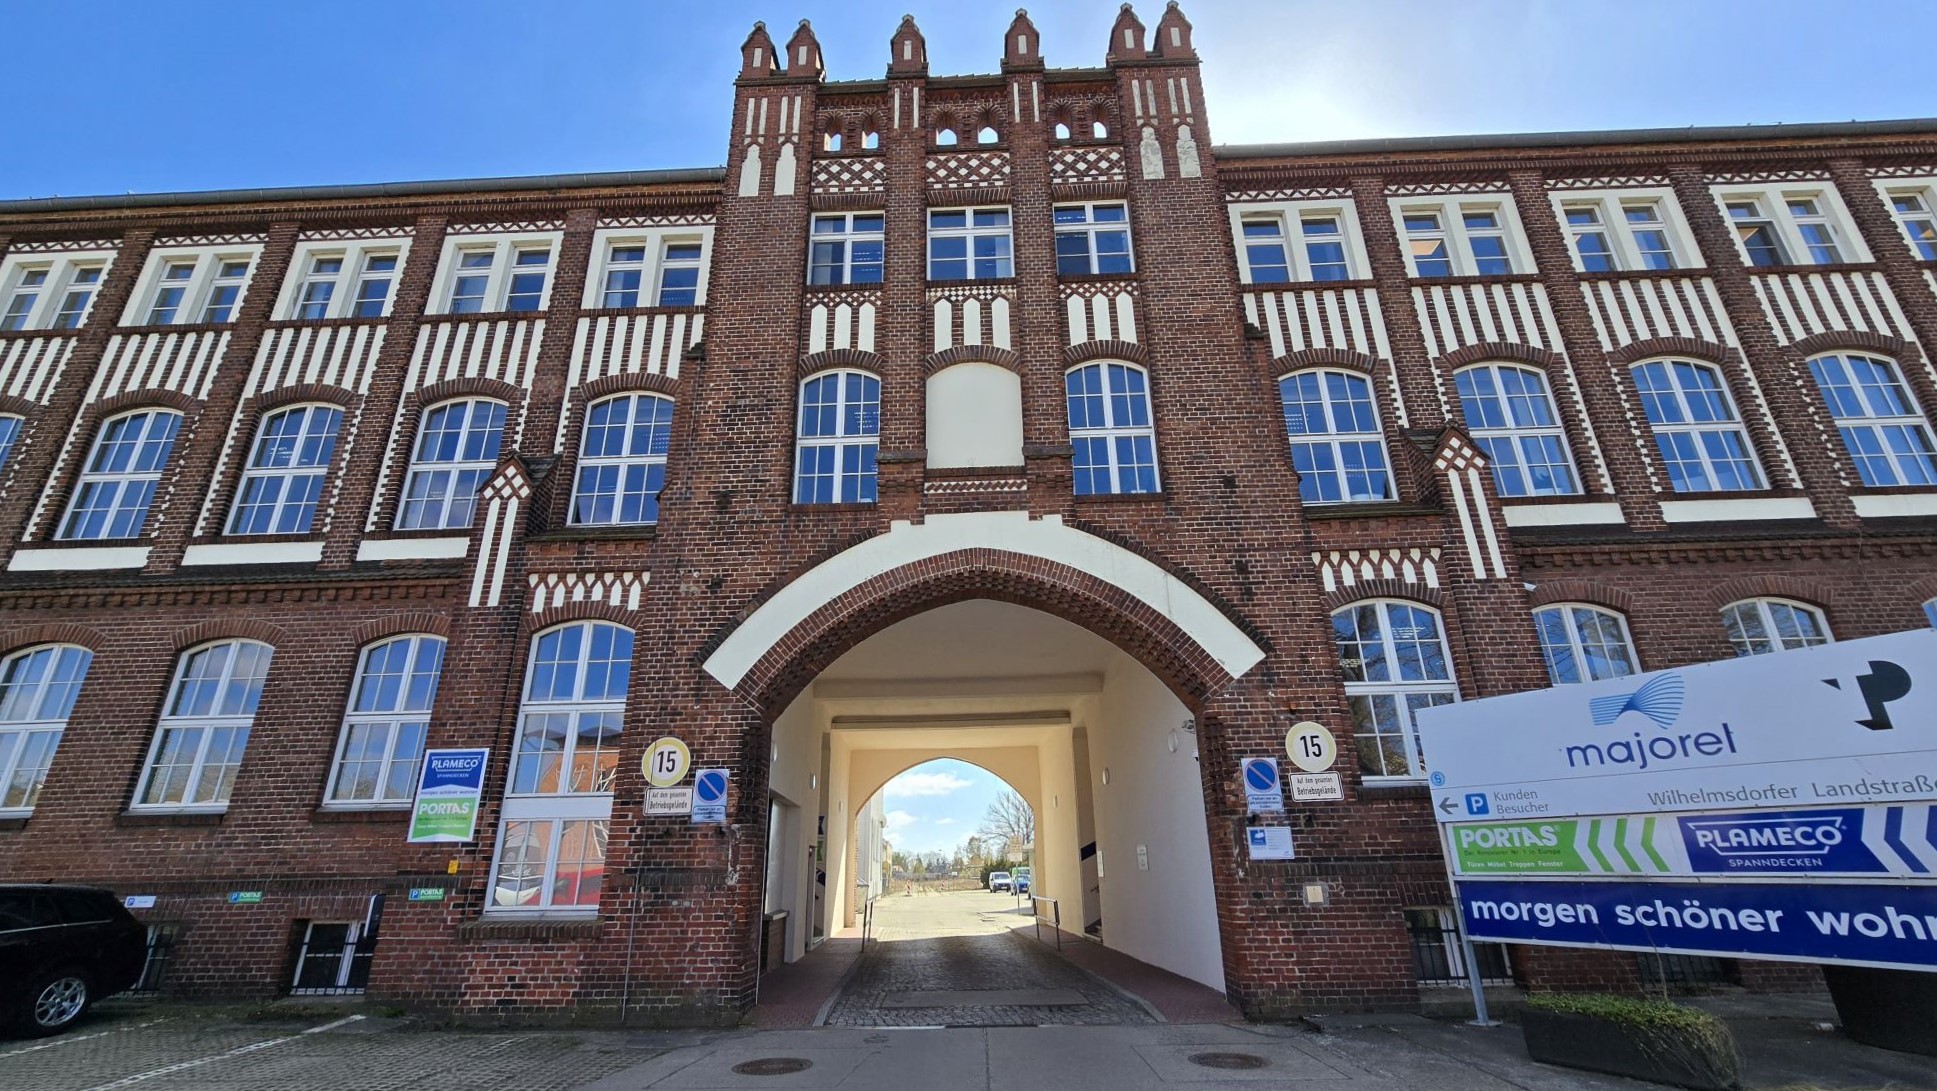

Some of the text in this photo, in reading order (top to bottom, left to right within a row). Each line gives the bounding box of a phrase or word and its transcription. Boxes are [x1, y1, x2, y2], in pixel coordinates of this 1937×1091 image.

[1299, 735, 1322, 758] 15
[432, 759, 479, 769] PLAMECO
[657, 750, 677, 773] 15
[1297, 786, 1336, 796] Betriebsgelände
[1493, 790, 1538, 802] Kunden
[1647, 774, 1937, 806] Wilhelmsdorfer Landstraß
[418, 803, 470, 815] PORTAS
[650, 801, 688, 811] Betriebsgelände
[1496, 802, 1550, 815] Besucher
[1460, 825, 1558, 849] PORTAS
[1695, 825, 1842, 848] PLAMECO
[1508, 861, 1535, 869] Treppen
[1538, 860, 1564, 868] Fenster
[1728, 857, 1823, 869] SPANNDECKEN
[1471, 900, 1599, 927] morgen
[1617, 899, 1783, 933] schöner
